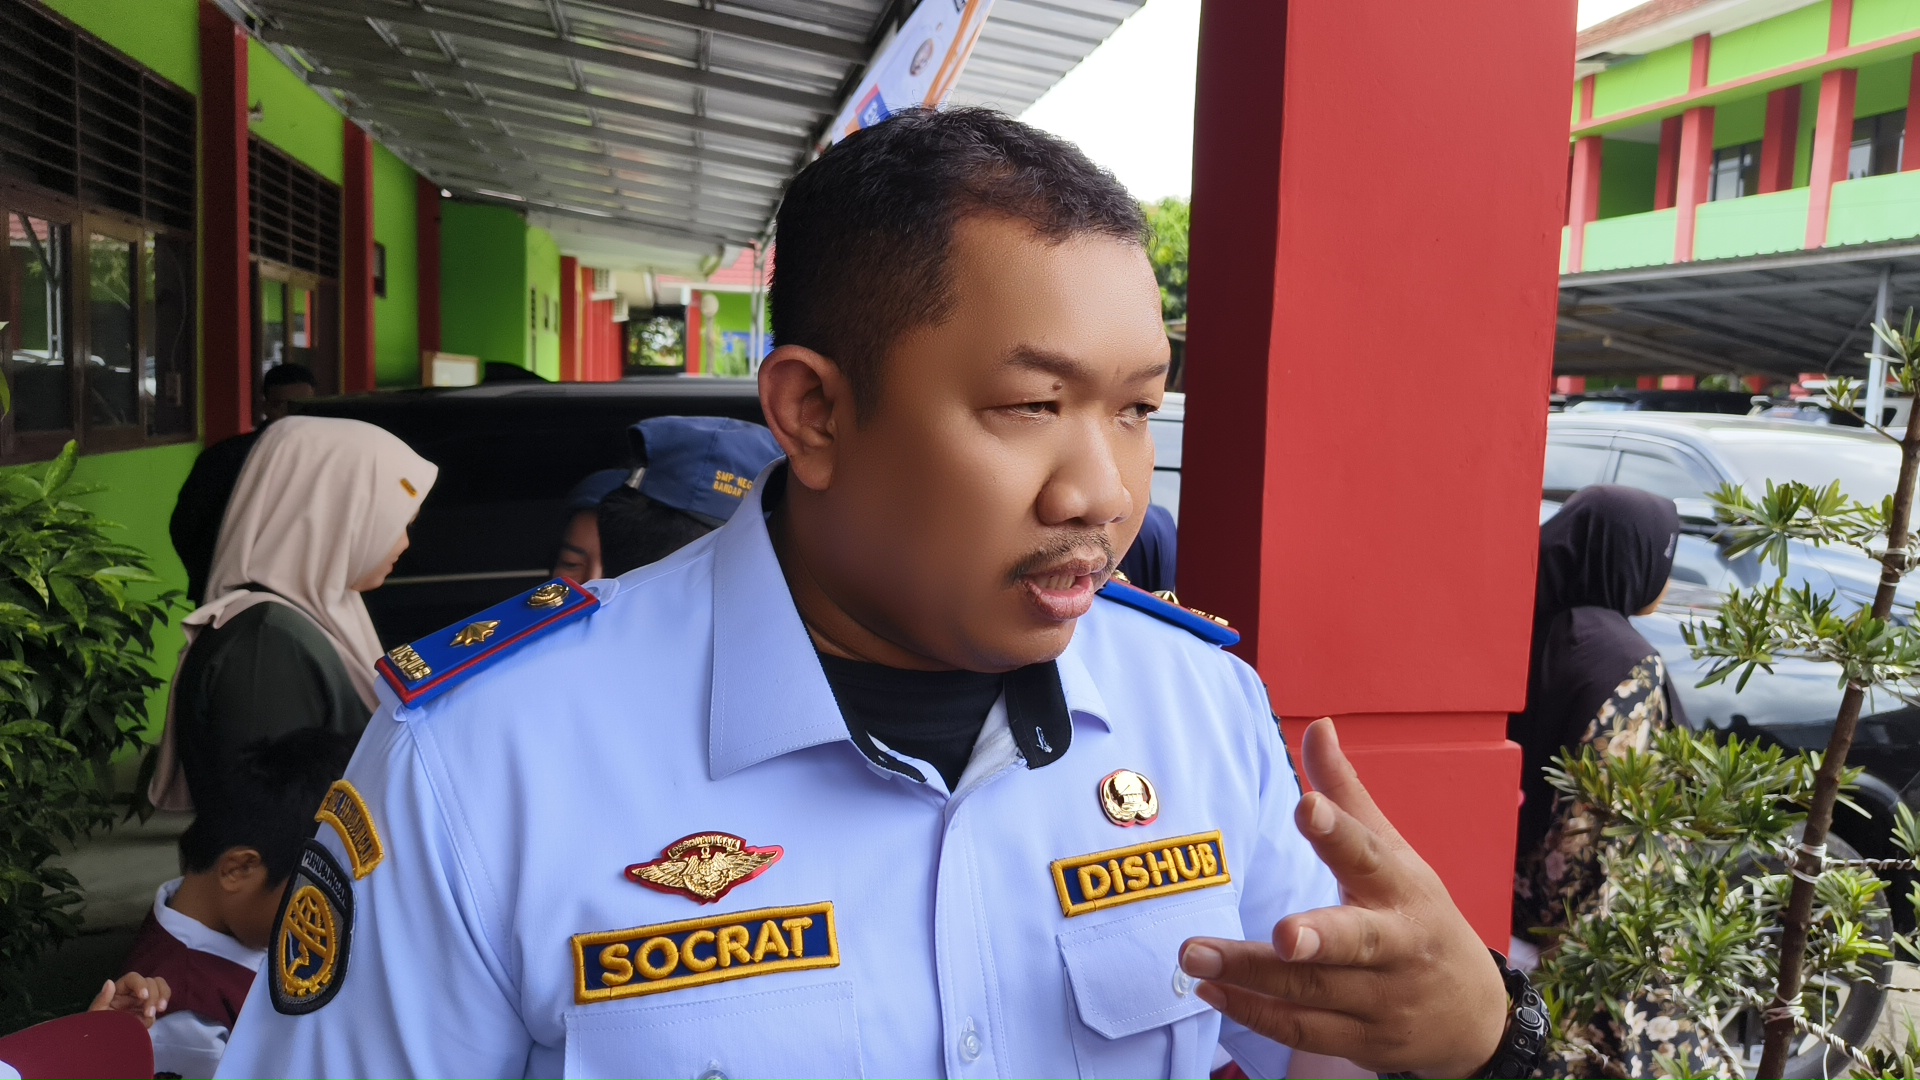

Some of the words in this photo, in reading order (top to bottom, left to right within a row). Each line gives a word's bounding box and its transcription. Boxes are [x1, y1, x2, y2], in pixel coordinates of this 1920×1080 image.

[714, 481, 743, 497] BANDAR
[716, 470, 735, 482] SMP
[1078, 843, 1218, 899] DISHUB
[599, 917, 813, 986] SOCRAT
